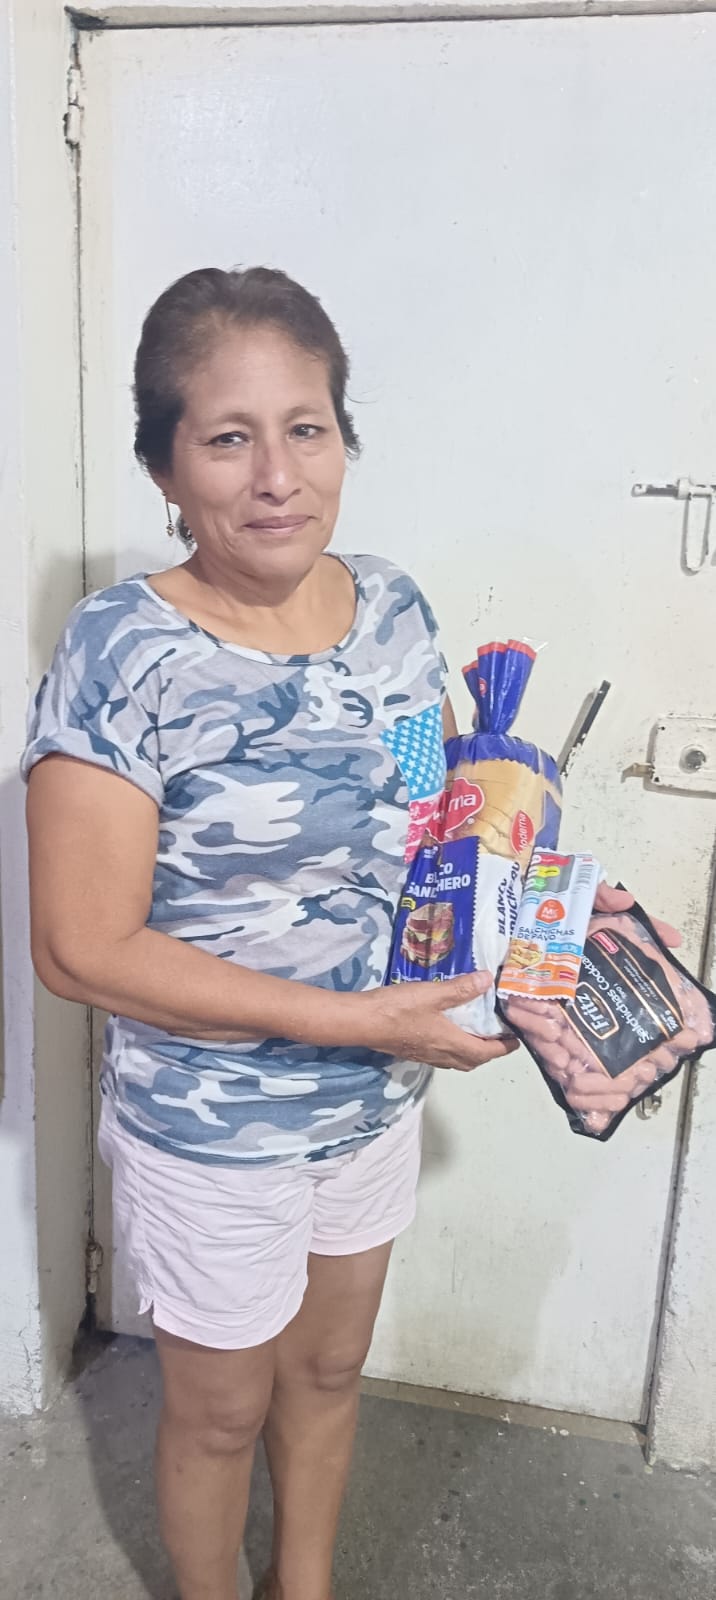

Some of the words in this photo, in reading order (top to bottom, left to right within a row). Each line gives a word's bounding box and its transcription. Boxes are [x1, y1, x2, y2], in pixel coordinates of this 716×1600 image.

[519, 927, 575, 936] SALCHICHAS
[531, 933, 557, 941] PAVO
[576, 993, 610, 1030] Fritz
[607, 989, 652, 1043] Salchichas
